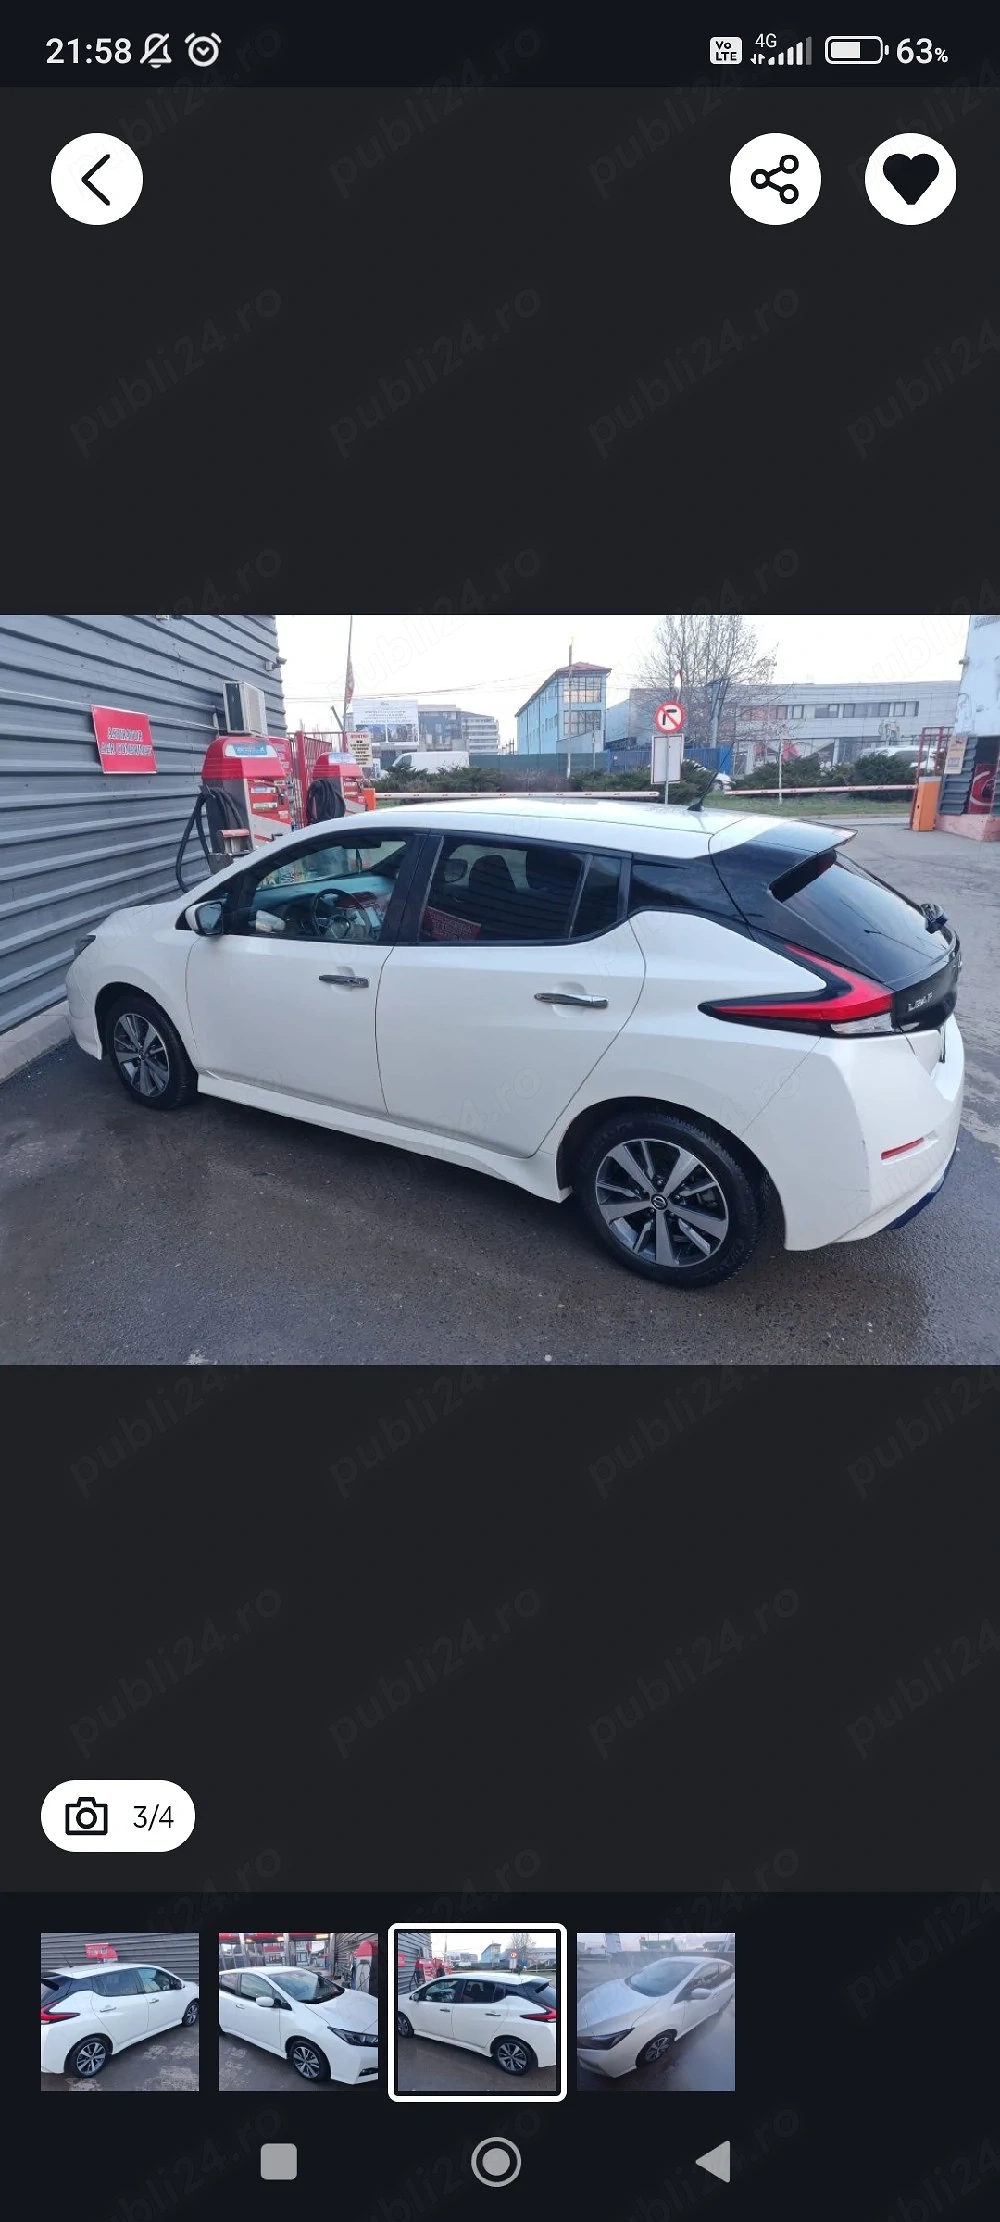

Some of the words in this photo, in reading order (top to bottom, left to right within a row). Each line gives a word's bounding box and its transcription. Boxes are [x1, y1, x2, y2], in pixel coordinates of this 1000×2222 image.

[755, 33, 777, 48] 4G
[46, 38, 132, 64] 21:58
[715, 51, 737, 60] LTE
[133, 1804, 174, 1831] 3/4
